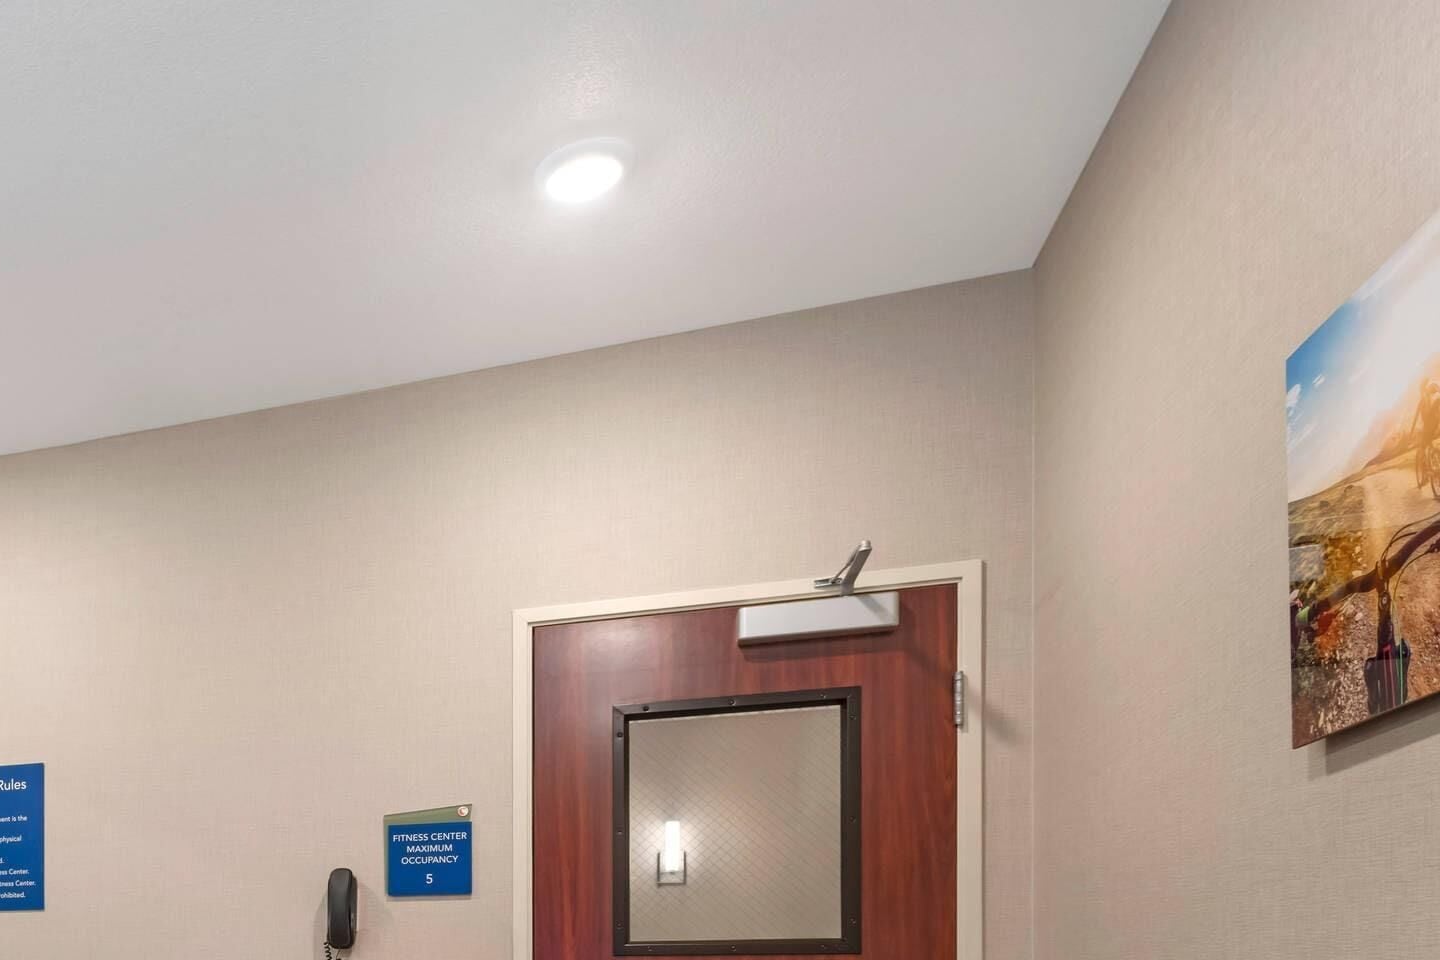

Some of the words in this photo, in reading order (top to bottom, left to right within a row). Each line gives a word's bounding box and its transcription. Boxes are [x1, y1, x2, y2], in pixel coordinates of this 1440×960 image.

[0, 835, 22, 844] physical
[392, 834, 429, 842] FITNESS
[430, 832, 467, 841] CENTER
[406, 844, 453, 853] MAXIMUM
[400, 855, 459, 864] OCCUPANCY
[426, 873, 433, 884] 5
